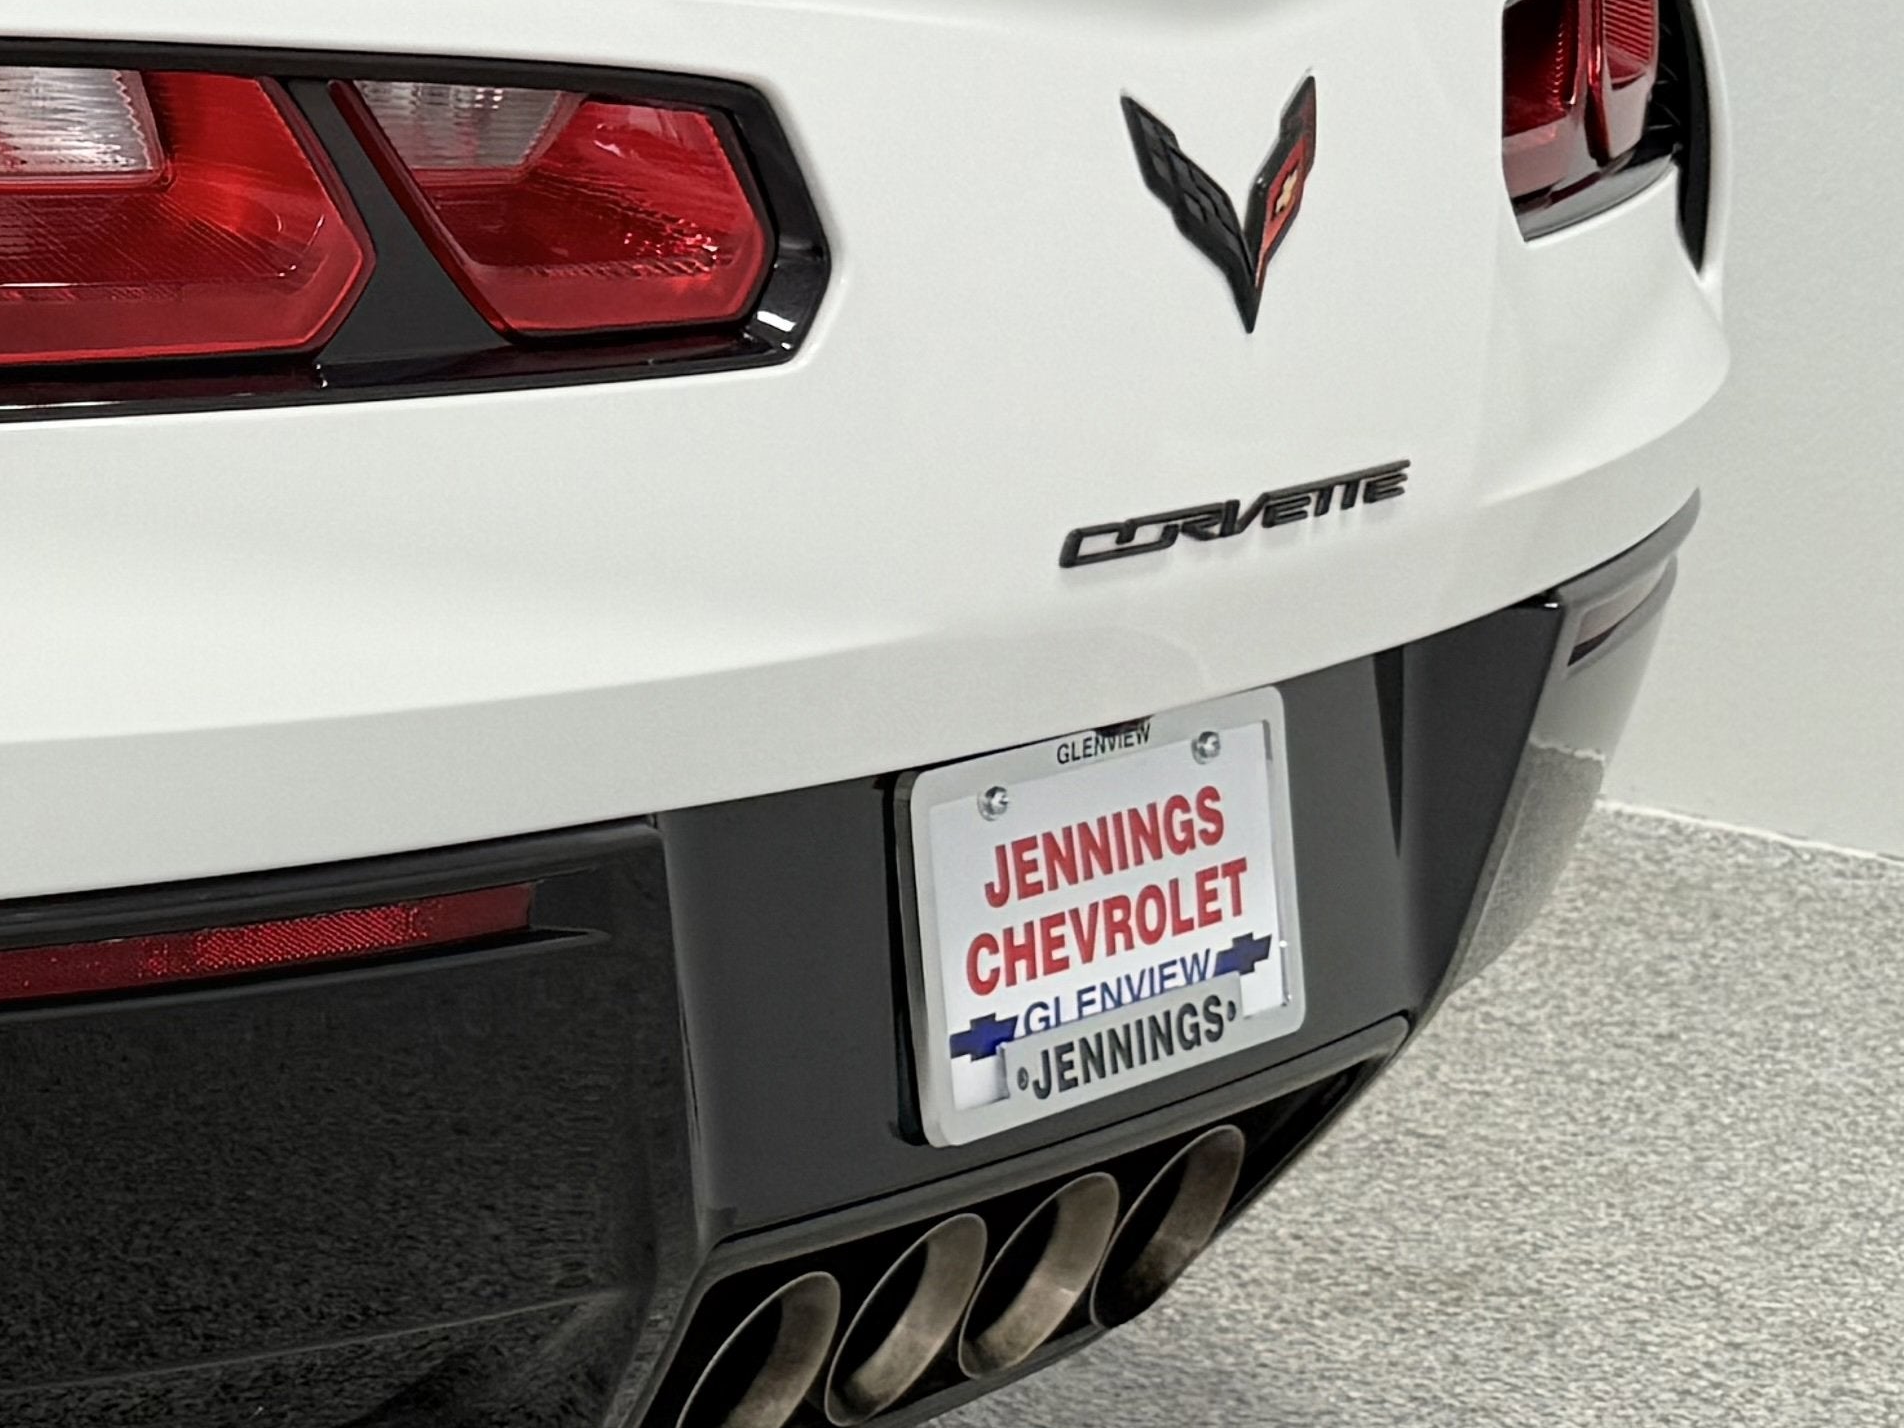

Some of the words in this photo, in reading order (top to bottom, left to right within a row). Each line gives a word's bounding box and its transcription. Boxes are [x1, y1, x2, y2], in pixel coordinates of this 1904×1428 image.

[1058, 459, 1411, 568] CORVETTE
[1056, 722, 1151, 765] GLENVIEW
[984, 785, 1225, 909] JENNINGS
[965, 857, 1248, 996] CHEVROLET
[1023, 948, 1212, 1037] GLENVIEW
[1032, 994, 1225, 1100] JENNINGS
